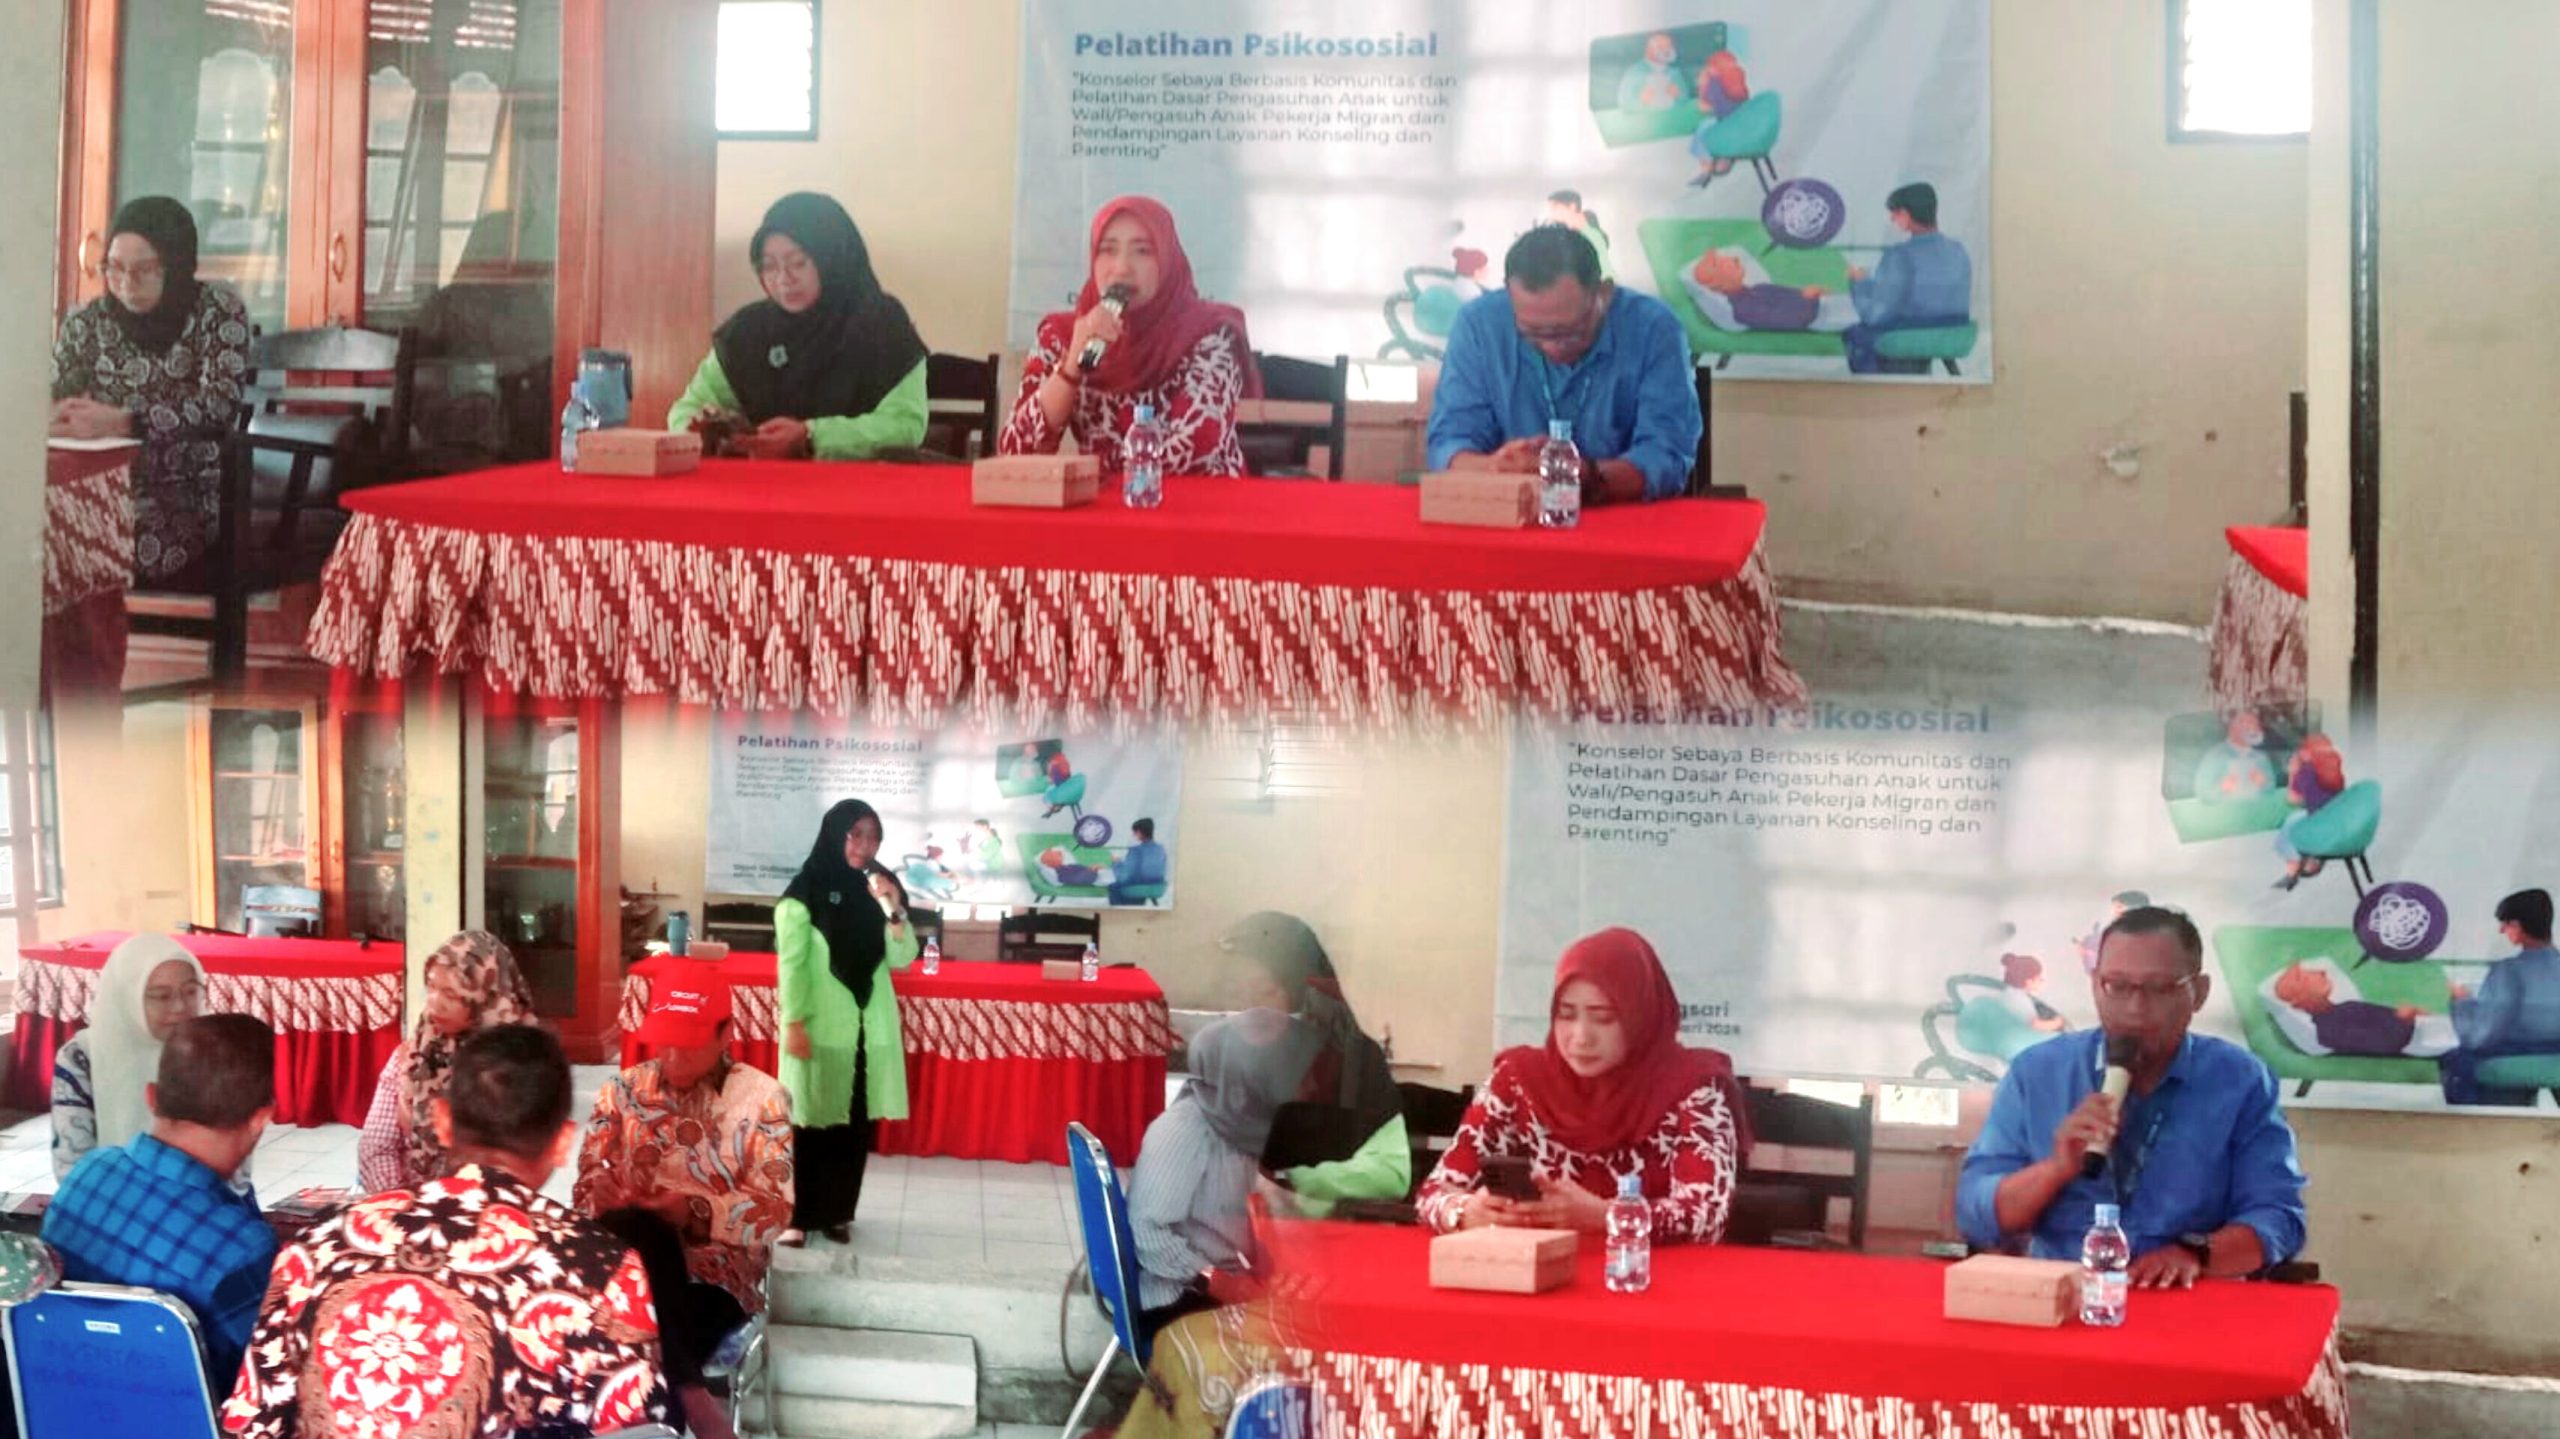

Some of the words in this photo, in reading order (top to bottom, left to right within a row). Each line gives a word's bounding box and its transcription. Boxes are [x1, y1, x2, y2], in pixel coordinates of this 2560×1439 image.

[1074, 32, 1233, 56] Pelatihan
[1244, 33, 1438, 57] Psikososial
[1162, 73, 1223, 89] Sebaya
[1230, 73, 1307, 88] Berbasis
[1314, 74, 1415, 88] Komunitas
[1421, 75, 1457, 88] dan
[1073, 90, 1158, 104] Pelatihan
[1162, 91, 1210, 105] Dasar
[1217, 92, 1332, 108] Pengasuhan
[1340, 92, 1386, 106] Anak
[1393, 93, 1450, 107] untuk
[1072, 108, 1206, 127] Wali/Pengasuh
[1211, 110, 1256, 123] Anak
[1263, 111, 1330, 127] Pekerja
[1338, 111, 1402, 128] Migran
[1409, 112, 1445, 125] dan
[1072, 126, 1211, 144] Pendampingan
[1217, 127, 1291, 145] Layanan
[1298, 128, 1390, 146] Konseling
[1396, 130, 1431, 143] dan
[1072, 144, 1166, 159] Parenting"
[737, 735, 820, 749] Pelatihan
[825, 738, 922, 752] Psikososial
[1570, 741, 1665, 760] "Konselor
[1672, 746, 1742, 765] Sebaya
[1751, 747, 1839, 765] Berbasis
[1847, 749, 1963, 769] Komunitas
[1969, 752, 2010, 771] dan
[1569, 762, 1666, 780] Pelatihan
[1673, 765, 1728, 783] Dasar
[1735, 768, 1868, 789] Pengasuhan
[1874, 772, 1931, 789] Anak
[1938, 773, 2001, 791] untuk
[1567, 783, 1720, 806] Wali/Pengasuh
[1729, 788, 1779, 805] Anak
[1787, 791, 1865, 810] Pekerja
[1872, 794, 1948, 814] Migran
[1955, 796, 1996, 812] dan
[1568, 804, 1728, 827] Pendampingan
[1734, 809, 1820, 828] Layanan
[1827, 812, 1932, 834] Konseling
[1938, 815, 1981, 833] dan
[1567, 823, 1676, 846] Parenting"
